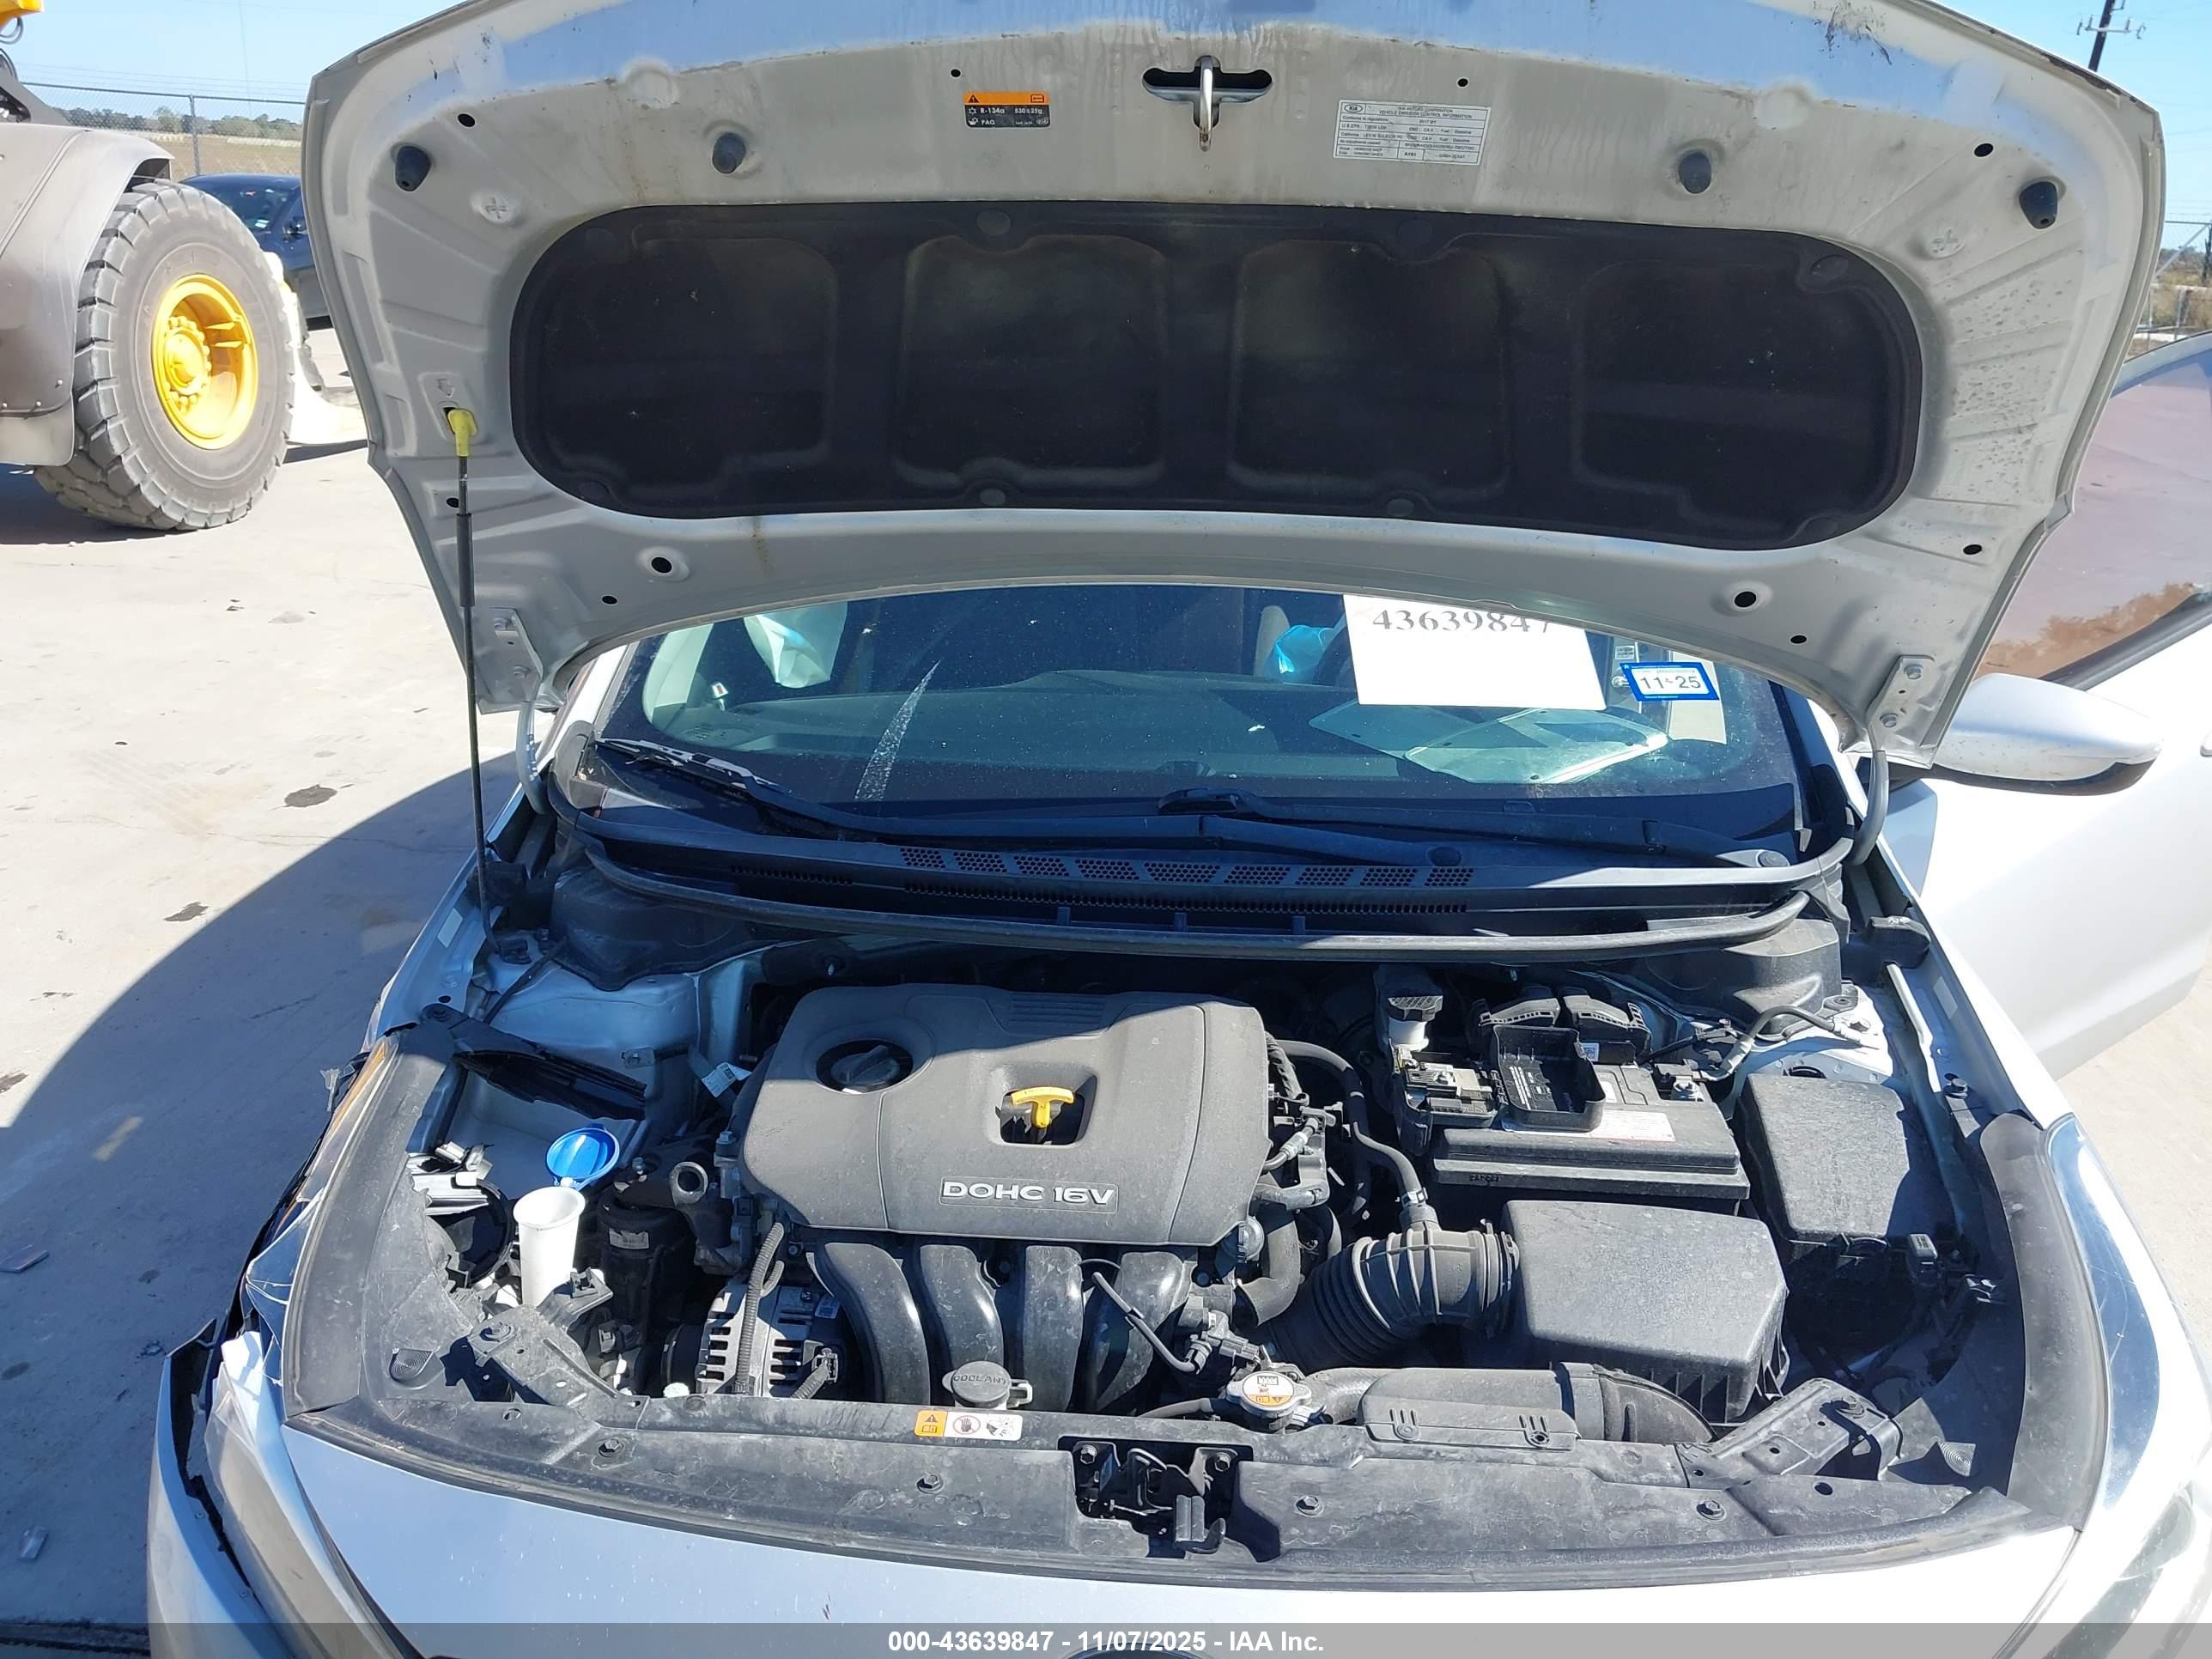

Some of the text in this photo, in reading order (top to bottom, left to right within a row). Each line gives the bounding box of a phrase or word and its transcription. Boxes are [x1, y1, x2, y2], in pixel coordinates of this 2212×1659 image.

[943, 1181, 1115, 1205] DOHC 16V
[952, 1375, 1007, 1385] COOLANT
